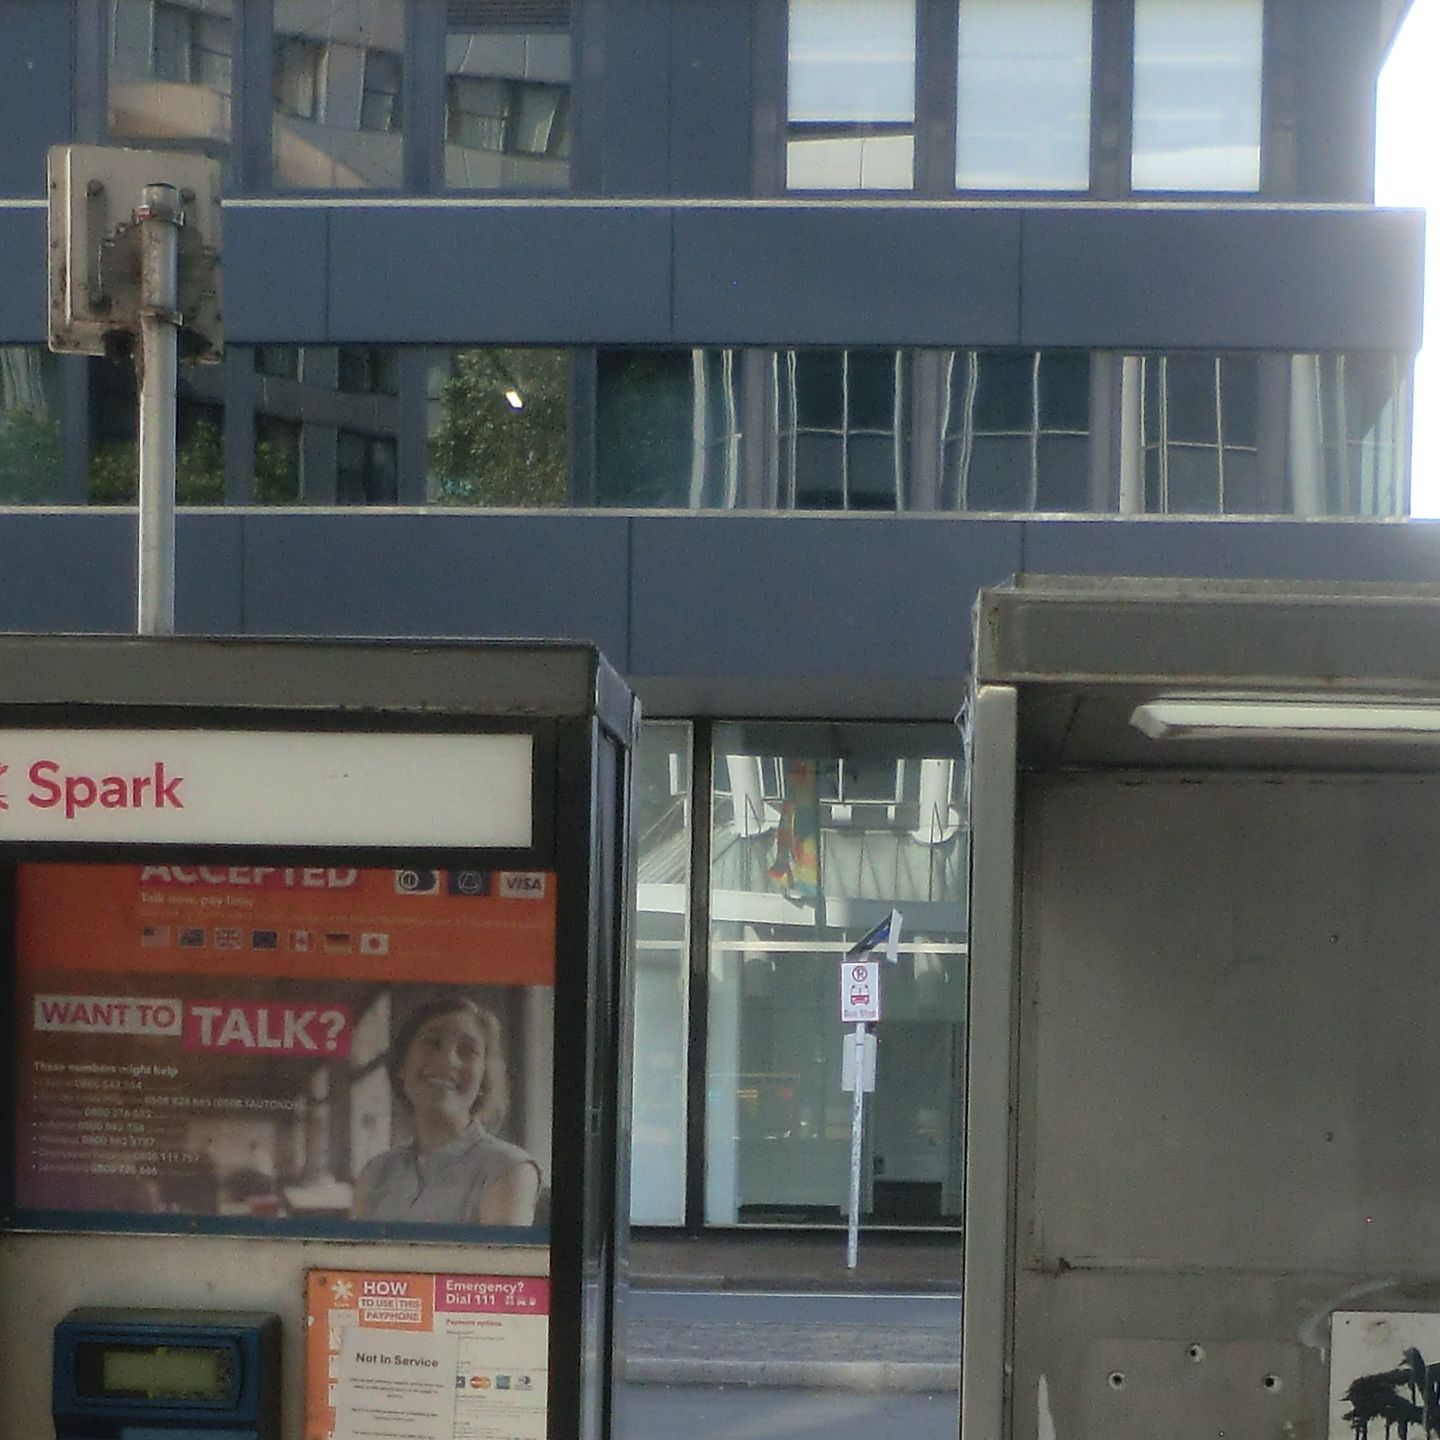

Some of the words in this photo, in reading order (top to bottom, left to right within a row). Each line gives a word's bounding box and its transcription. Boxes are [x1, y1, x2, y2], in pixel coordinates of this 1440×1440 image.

[26, 760, 185, 820] Spark
[141, 865, 358, 888] ACCEPTED
[505, 877, 542, 890] VISA
[40, 1000, 128, 1026] WANT
[134, 1003, 176, 1029] TO
[190, 1005, 347, 1051] TALK?
[33, 1061, 66, 1073] These
[68, 1062, 117, 1074] numbers
[118, 1064, 151, 1077] might
[153, 1064, 179, 1078] help
[363, 1281, 408, 1296] HOW
[445, 1279, 525, 1295] Emergency?
[360, 1298, 375, 1308] TO
[376, 1299, 395, 1309] USE
[398, 1300, 420, 1310] THIS
[445, 1293, 472, 1306] Dial
[474, 1294, 496, 1306] 111
[365, 1311, 420, 1322] PAYPHONE
[356, 1352, 378, 1363] Not
[380, 1354, 392, 1365] In
[394, 1354, 439, 1368] Service
